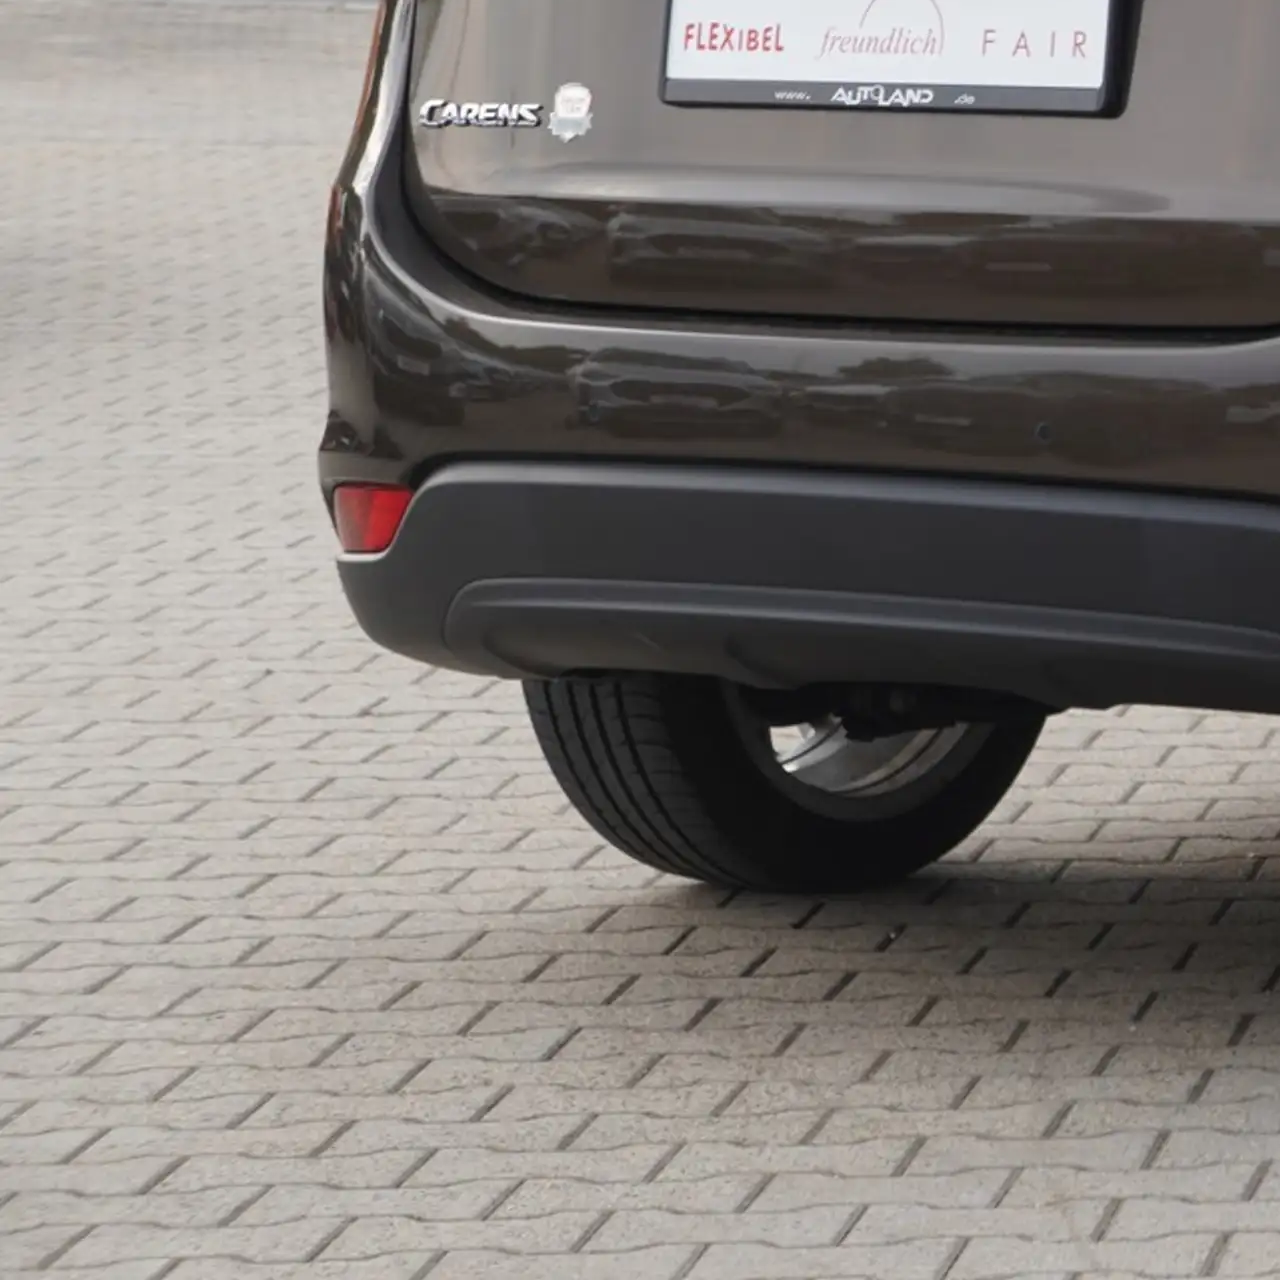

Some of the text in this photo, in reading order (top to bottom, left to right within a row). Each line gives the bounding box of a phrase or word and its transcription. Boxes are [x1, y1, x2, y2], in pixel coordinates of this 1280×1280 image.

[683, 21, 785, 53] FLEXIBEL
[816, 24, 940, 59] freundlich
[980, 28, 1088, 59] FAIR
[830, 83, 935, 108] AUTOLAND
